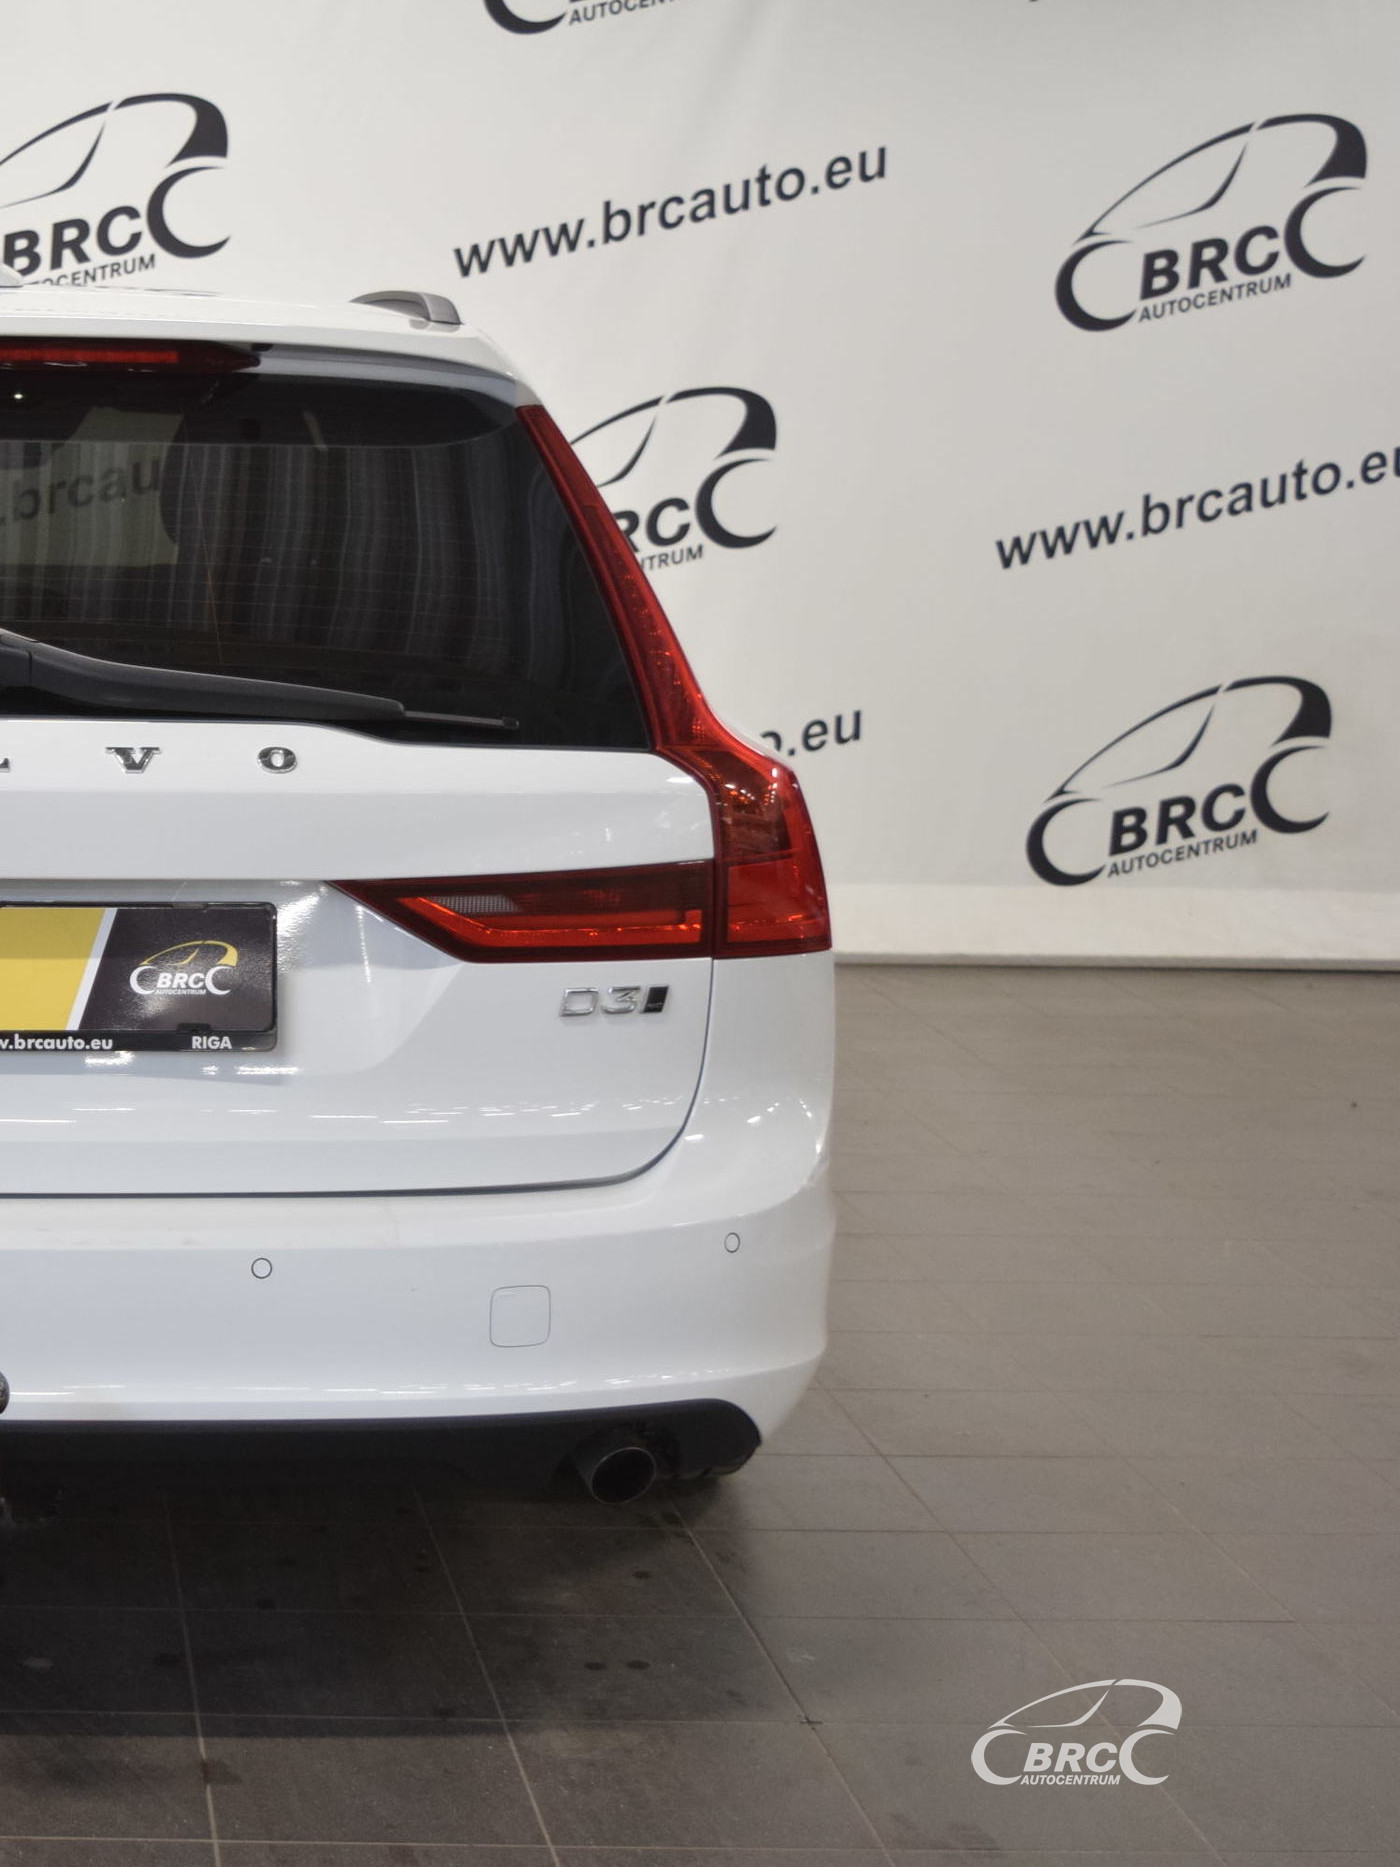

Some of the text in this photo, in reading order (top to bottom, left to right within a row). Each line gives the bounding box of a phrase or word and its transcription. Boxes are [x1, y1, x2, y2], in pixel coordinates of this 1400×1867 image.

[453, 145, 888, 279] www.brcauto.eu
[2, 205, 142, 277] BRC
[1139, 225, 1280, 301] BRC
[1138, 272, 1292, 323] AUTOCENTRUM
[613, 497, 691, 553] RC
[1108, 783, 1246, 857] BRC
[1107, 828, 1258, 878] AUTOCENTRUM
[156, 972, 205, 989] BRC
[191, 1036, 233, 1050] RIGA
